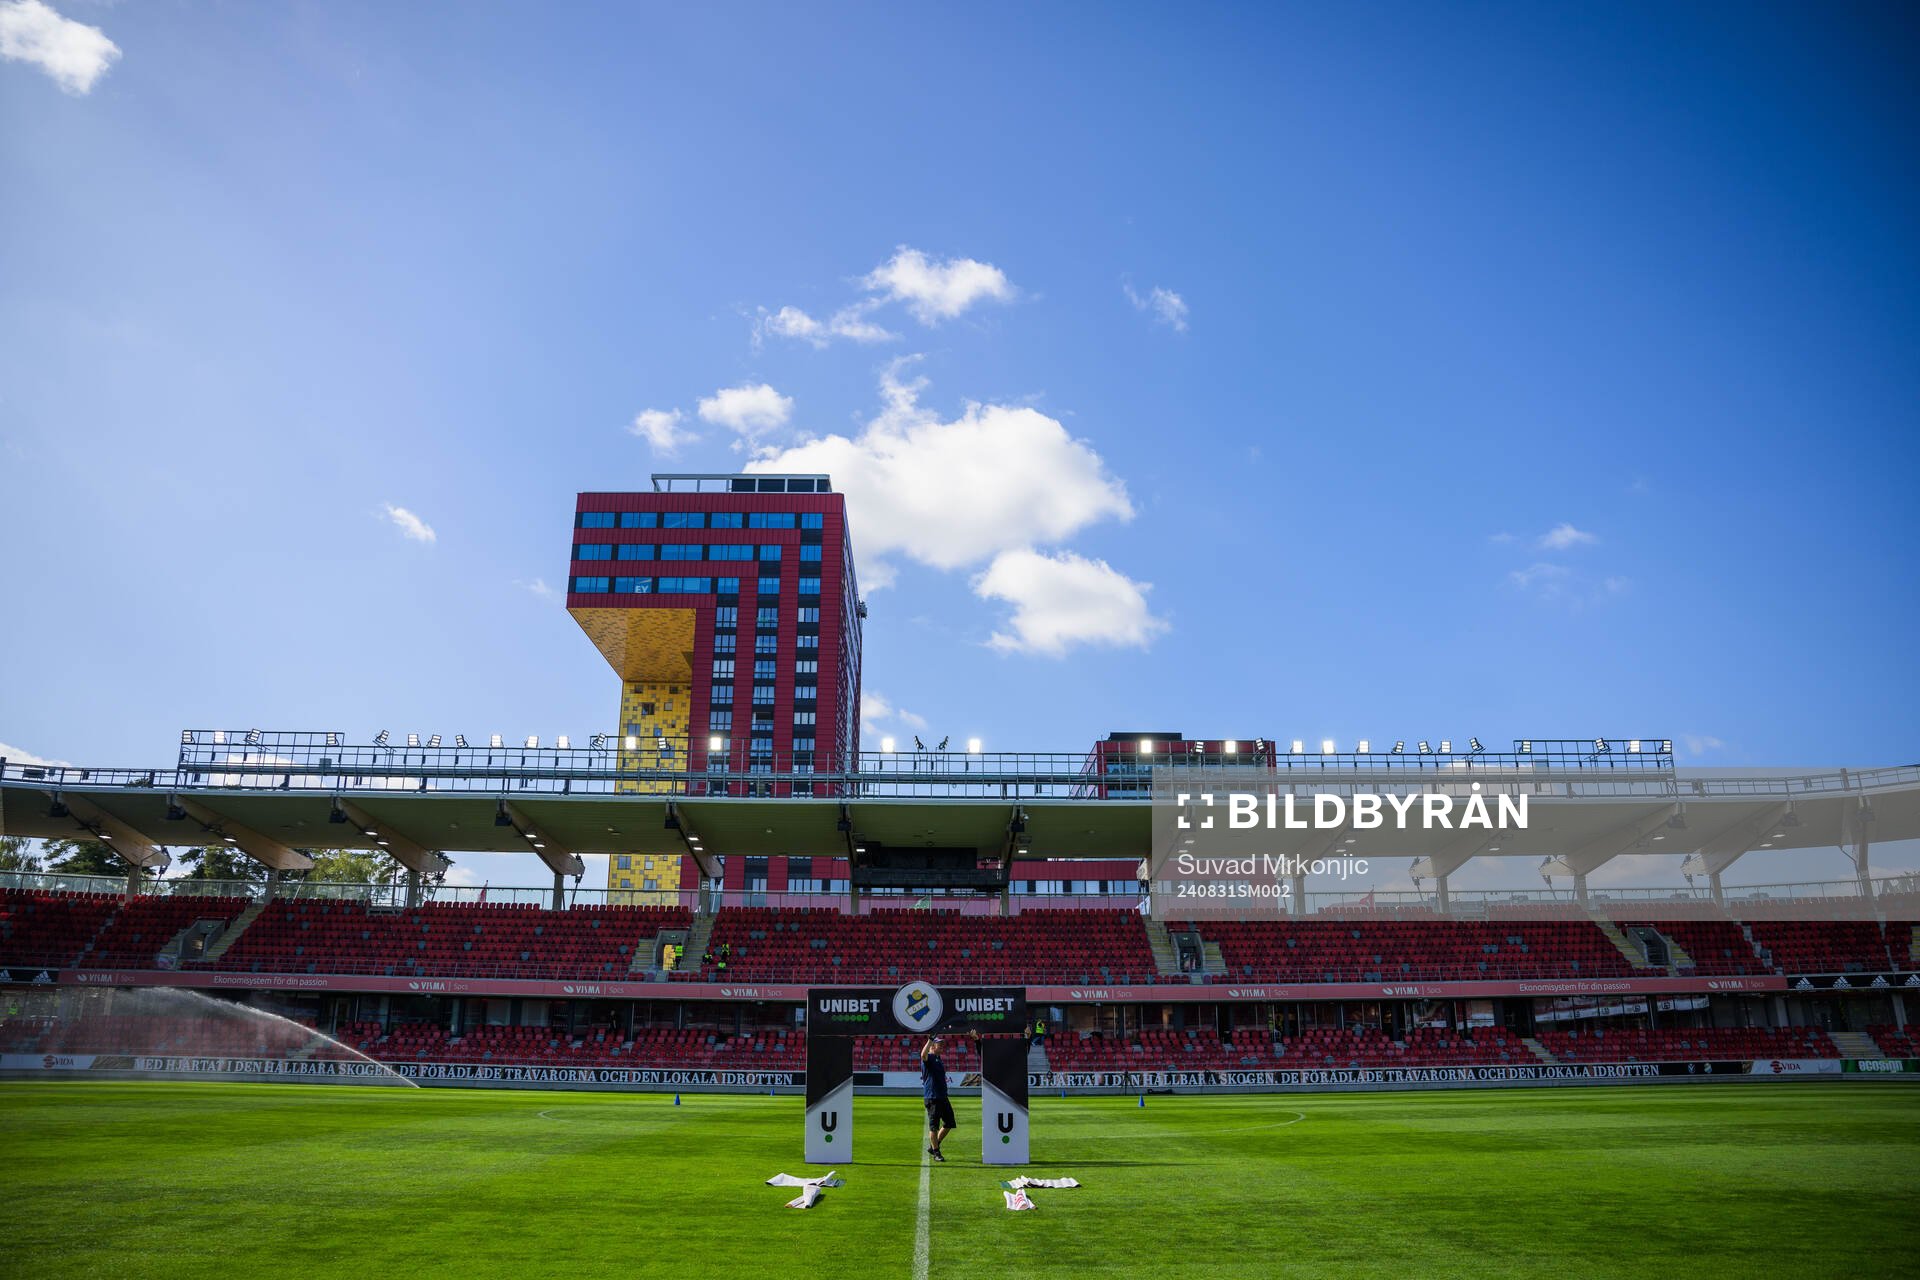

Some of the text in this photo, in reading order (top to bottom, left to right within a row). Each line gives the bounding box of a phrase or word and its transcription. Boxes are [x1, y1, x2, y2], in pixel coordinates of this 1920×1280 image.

[635, 585, 649, 594] EY
[89, 973, 112, 983] VISMA
[214, 975, 328, 987] Ekonomisystem för din passion
[421, 981, 445, 991] VISMA
[576, 985, 600, 995] VISMA
[1519, 982, 1631, 993] Ekonomisystem för din passion
[1719, 980, 1743, 990] VISMA
[733, 988, 758, 998] VISMA
[1083, 990, 1108, 999] VISMA
[1240, 988, 1266, 998] VISMA
[1395, 986, 1419, 996] VISMA
[820, 999, 880, 1013] UNIBET
[955, 998, 1015, 1012] UNIBET
[1780, 1063, 1801, 1071] VIDA
[235, 1061, 263, 1073] DEN
[400, 1065, 417, 1077] DE
[504, 1065, 597, 1082] TRÄVARORNA
[600, 1070, 629, 1083] OCH
[632, 1071, 660, 1083] DEN
[663, 1072, 719, 1084] LOKALA
[722, 1073, 793, 1086] IDROTTEN
[1281, 1072, 1299, 1084] DE
[1386, 1067, 1476, 1082] TRÄVARORNA
[1478, 1068, 1508, 1080] OCH
[1509, 1067, 1535, 1079] DEN
[1538, 1066, 1590, 1079] LOKALA
[1592, 1064, 1660, 1078] IDROTTEN
[821, 1112, 837, 1132] U
[998, 1113, 1013, 1133] U
